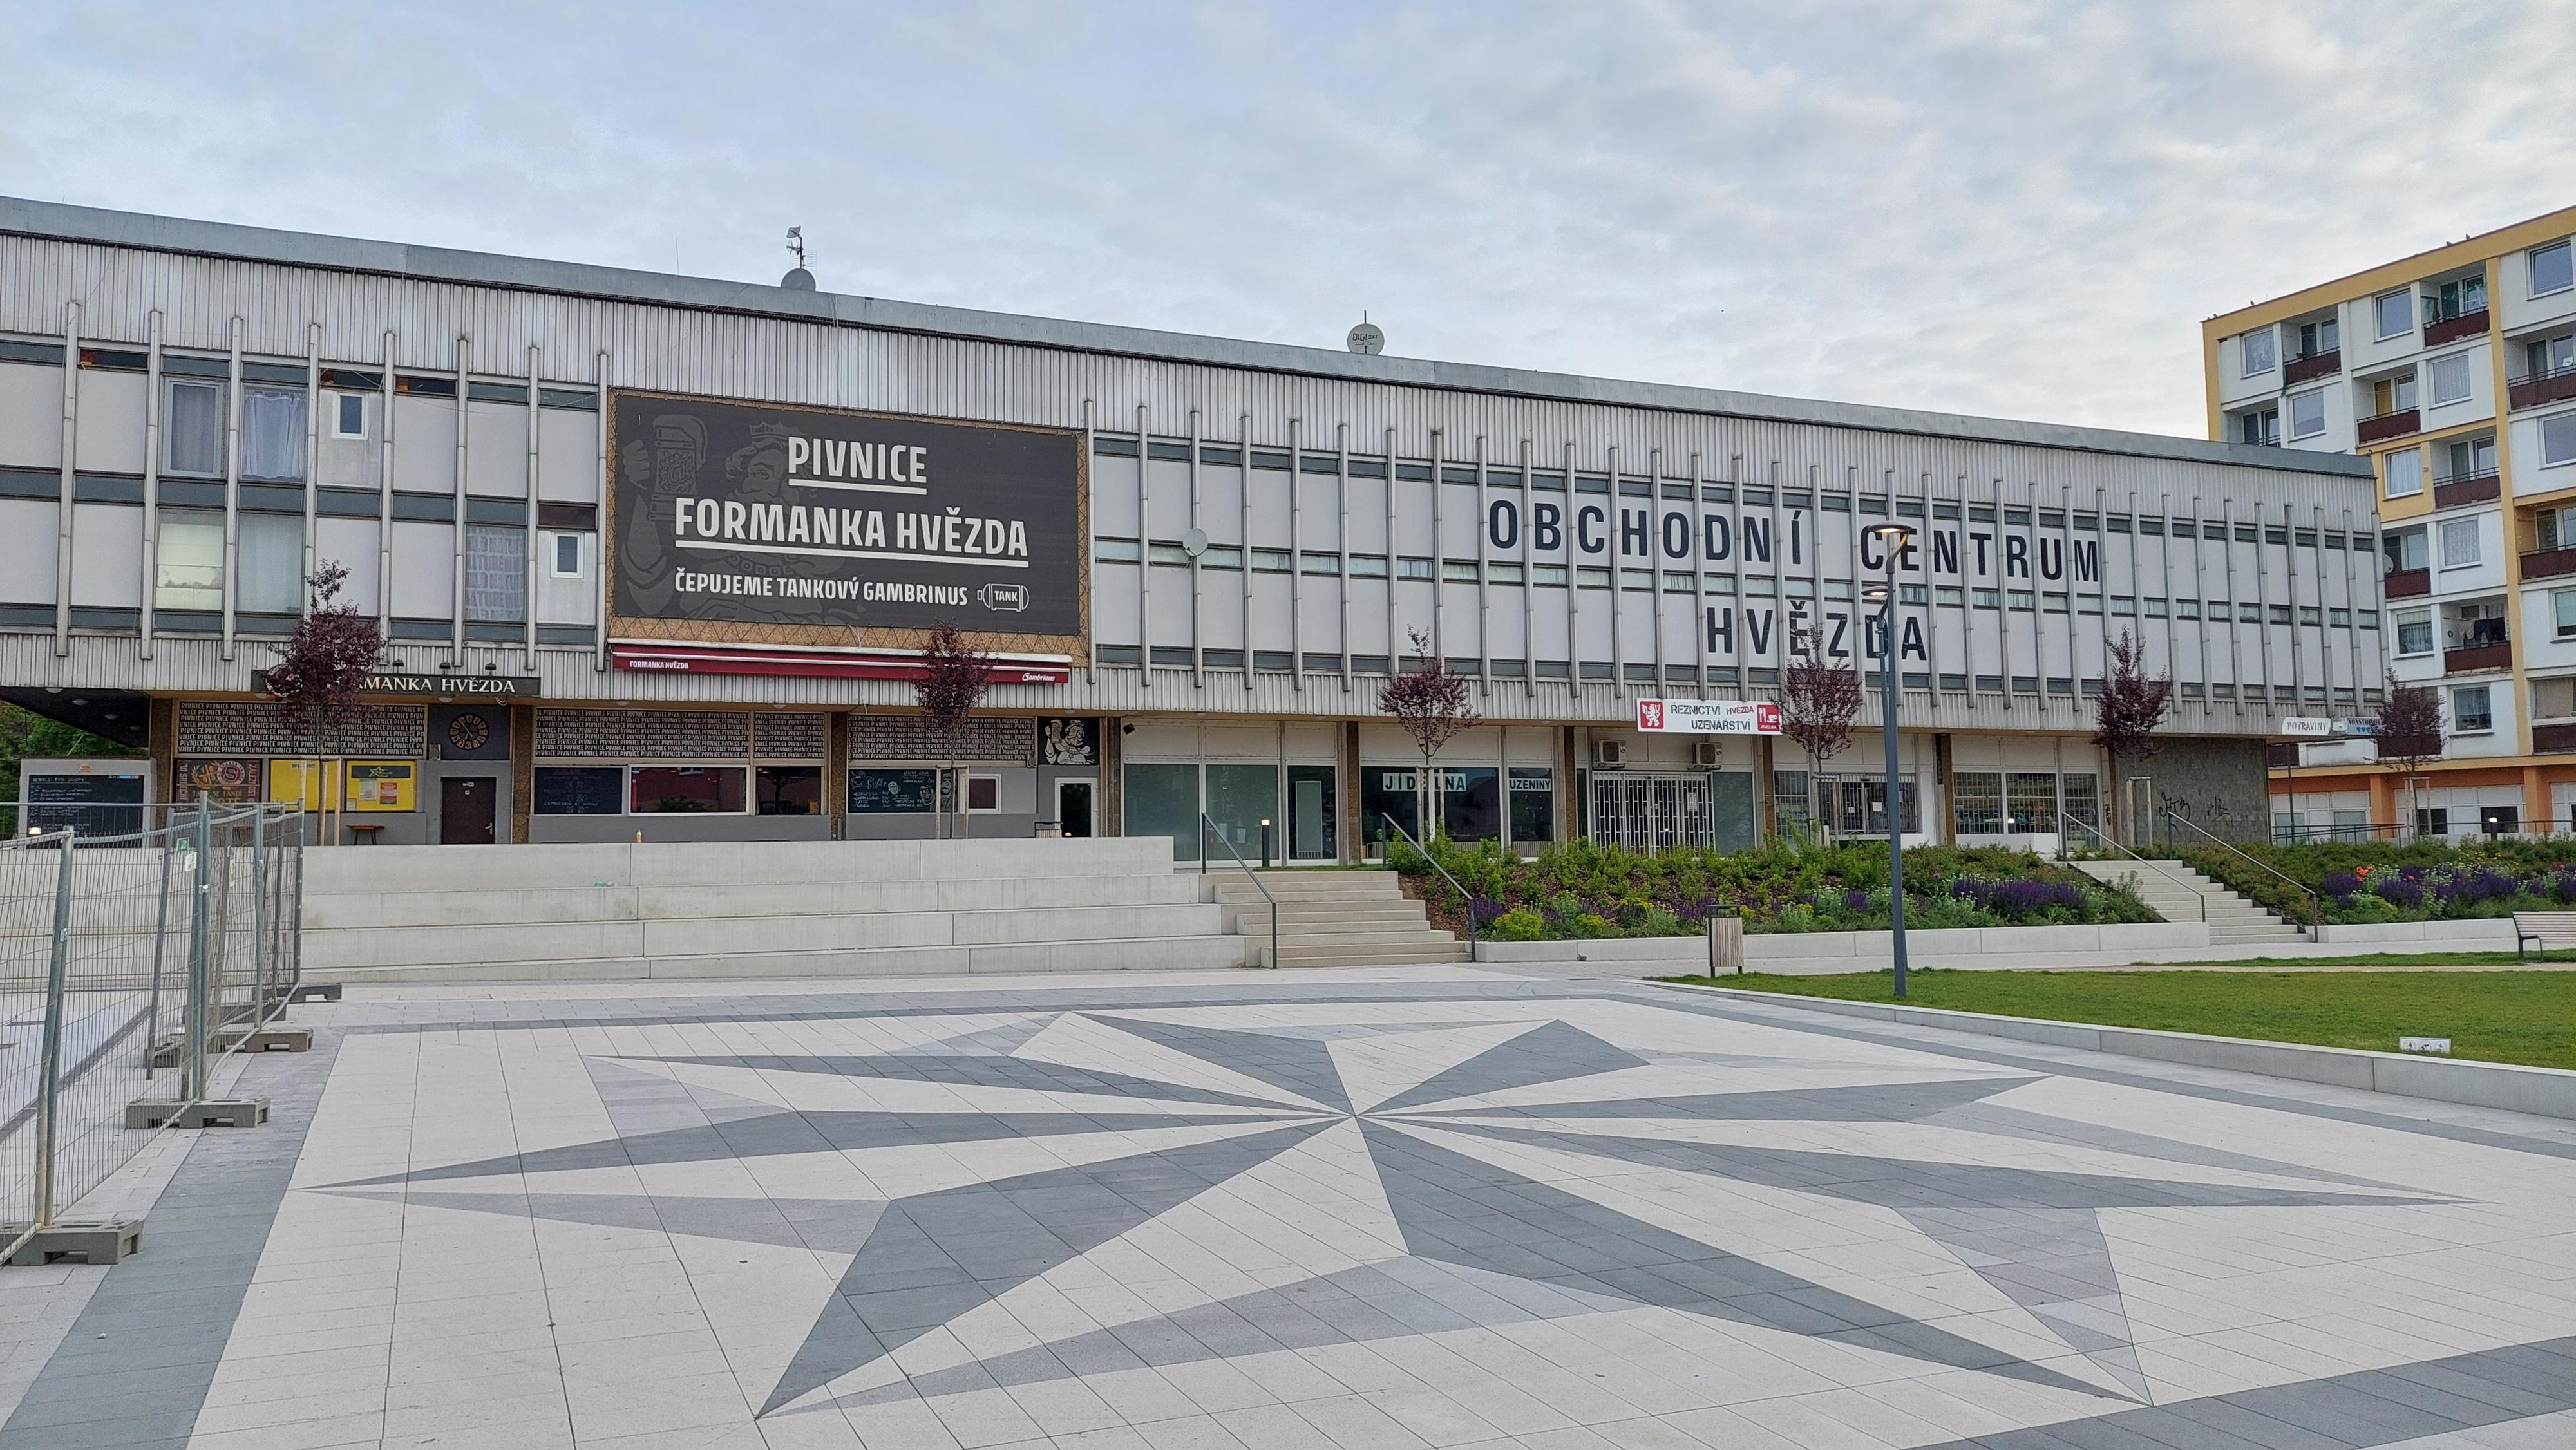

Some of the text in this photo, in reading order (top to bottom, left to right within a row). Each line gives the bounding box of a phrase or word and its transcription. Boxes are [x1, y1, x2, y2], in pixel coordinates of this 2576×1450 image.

[788, 437, 927, 483] PIVNICE
[676, 498, 1028, 556] FORMANKA HVĚZDA
[1488, 499, 2099, 583] OBCHODNÍ CENTRUM
[676, 567, 1018, 605] ČEPUJEME TANKOVÝ GAMBRINUS TANK
[1705, 600, 1927, 661] HVĚZDA
[629, 660, 689, 670] FORMANKA HVĚZDA
[1021, 672, 1056, 681] Gambrinus
[441, 677, 515, 693] HVĚZDA
[1671, 702, 1721, 715] ŘEZNICTVÍ
[1691, 717, 1750, 731] UZENÁŘSTVÍ
[2287, 721, 2327, 731] POTRAVINY
[1509, 780, 1551, 790] UZENINY
